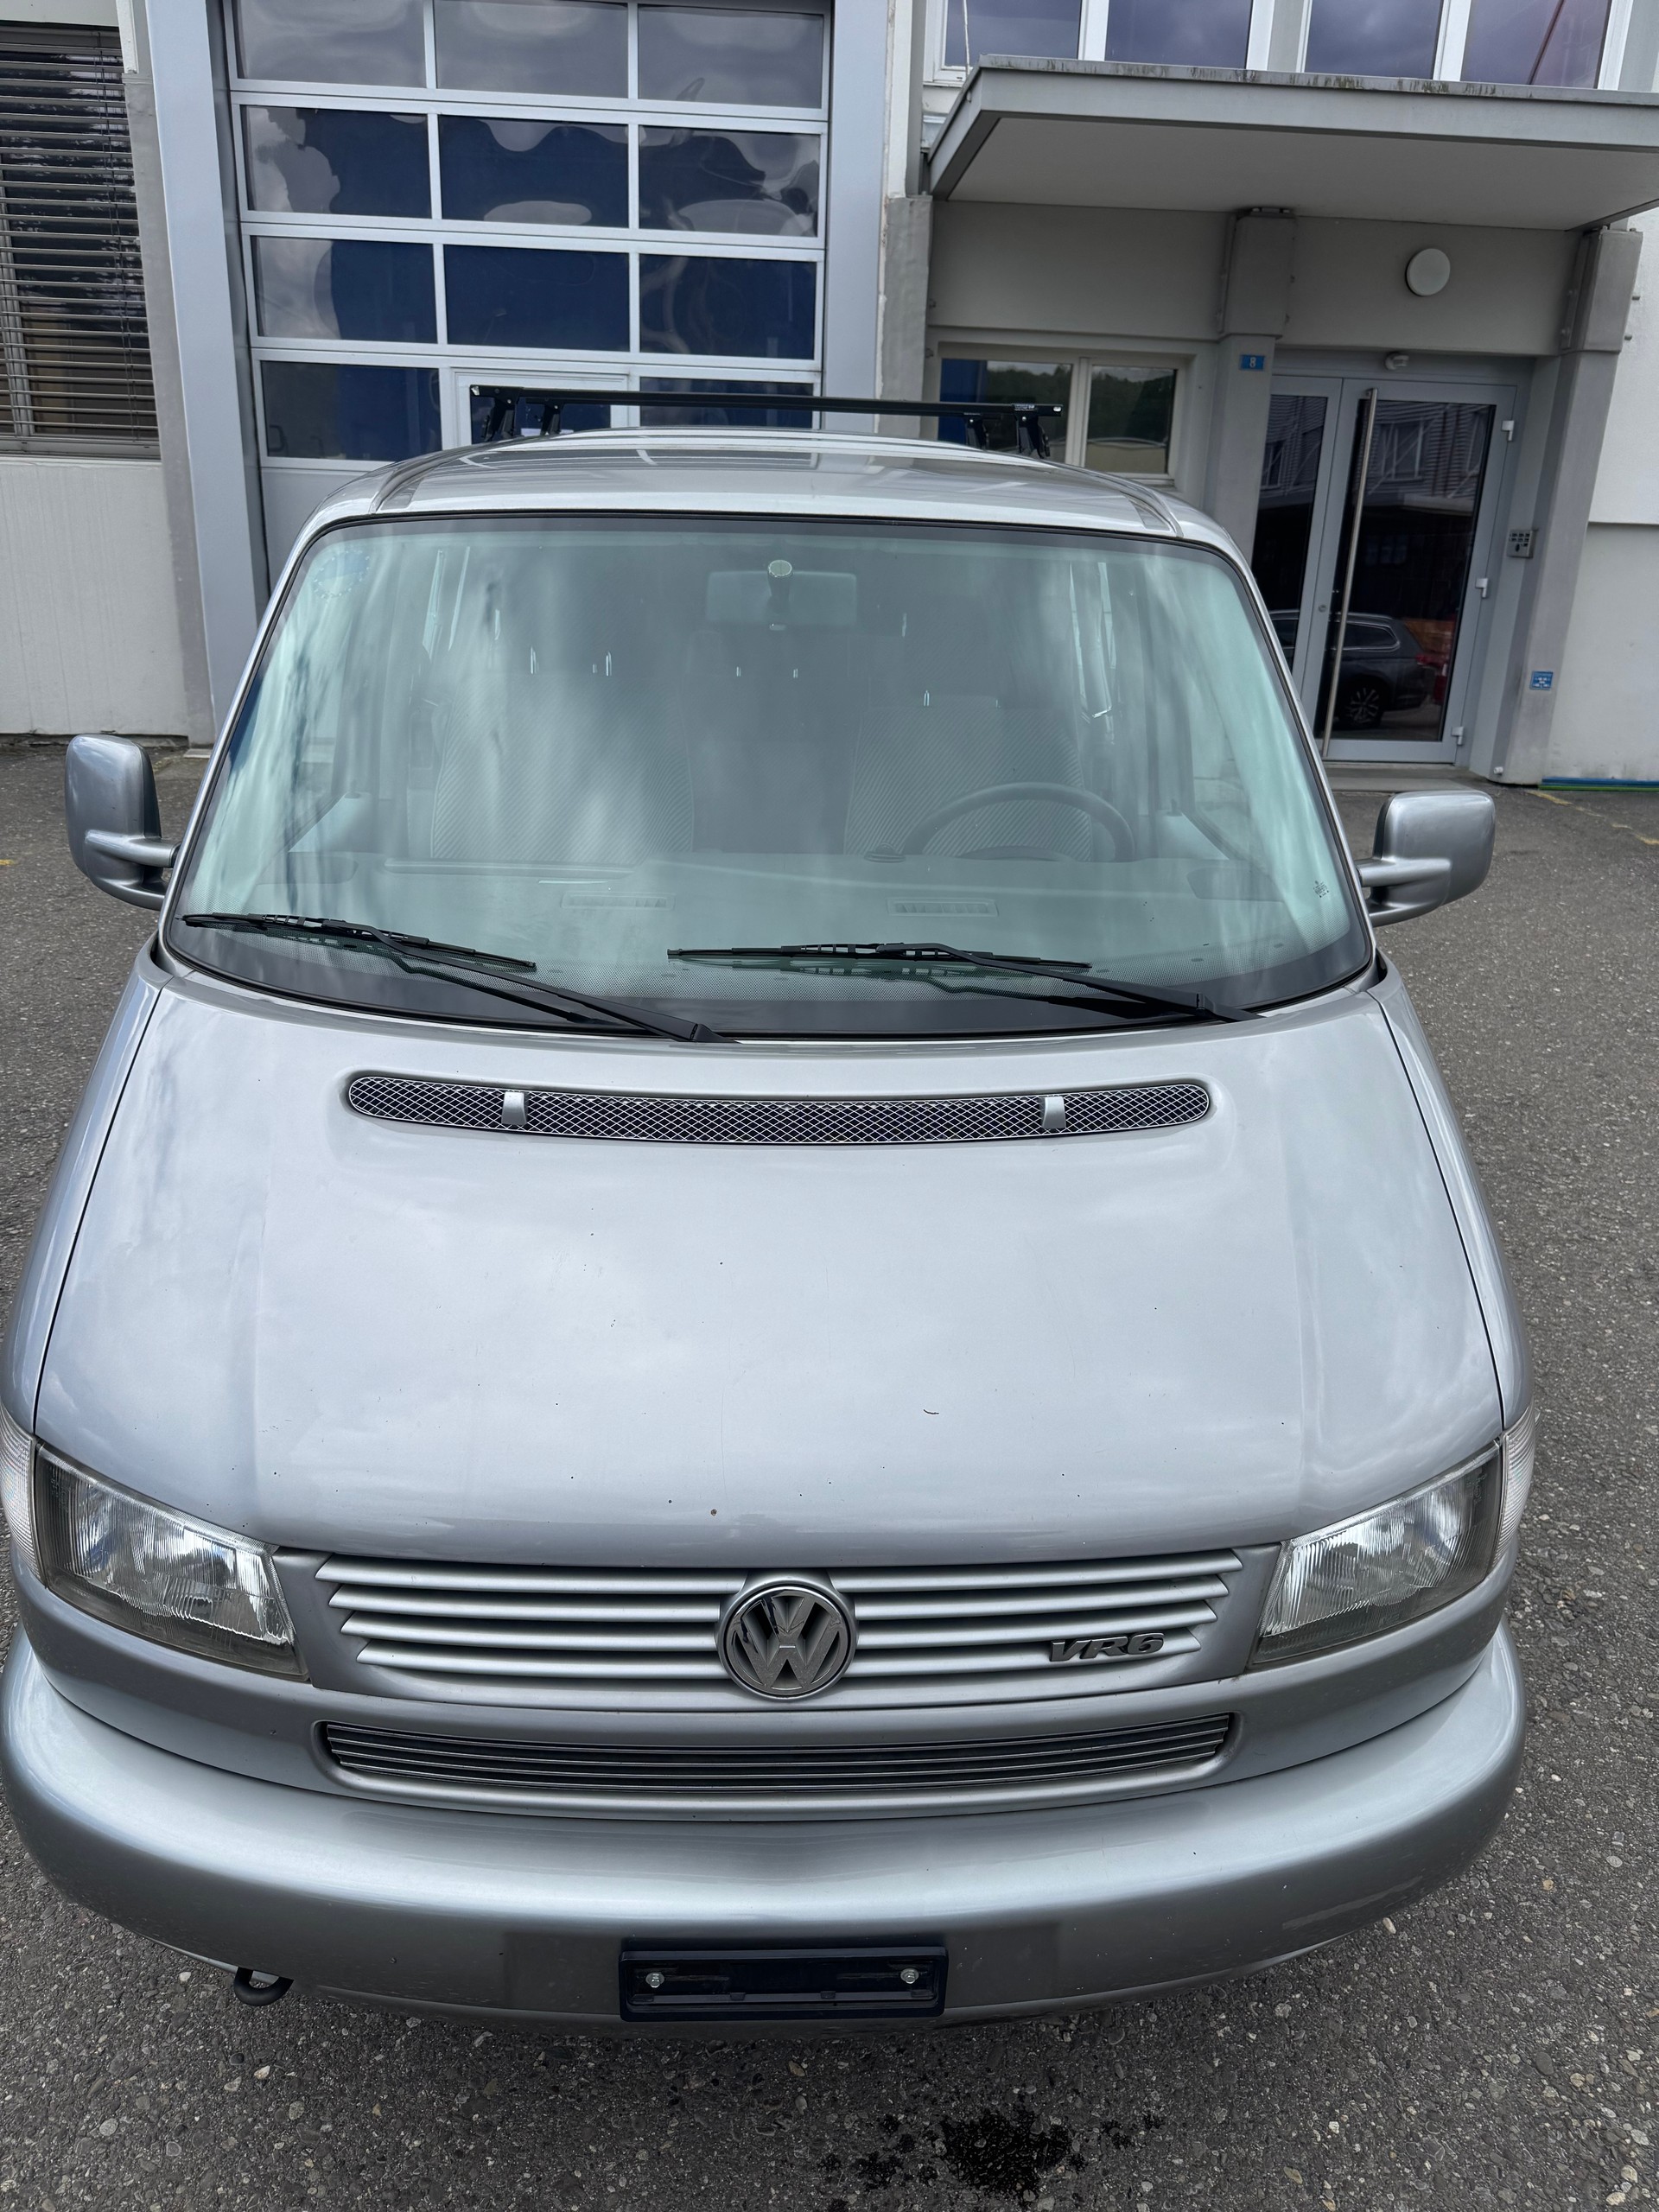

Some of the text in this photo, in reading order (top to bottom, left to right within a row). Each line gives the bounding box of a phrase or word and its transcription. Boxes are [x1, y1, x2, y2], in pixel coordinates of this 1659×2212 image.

[1249, 356, 1256, 368] 8
[727, 1589, 848, 1694] VW
[1050, 1632, 1165, 1662] VR6
